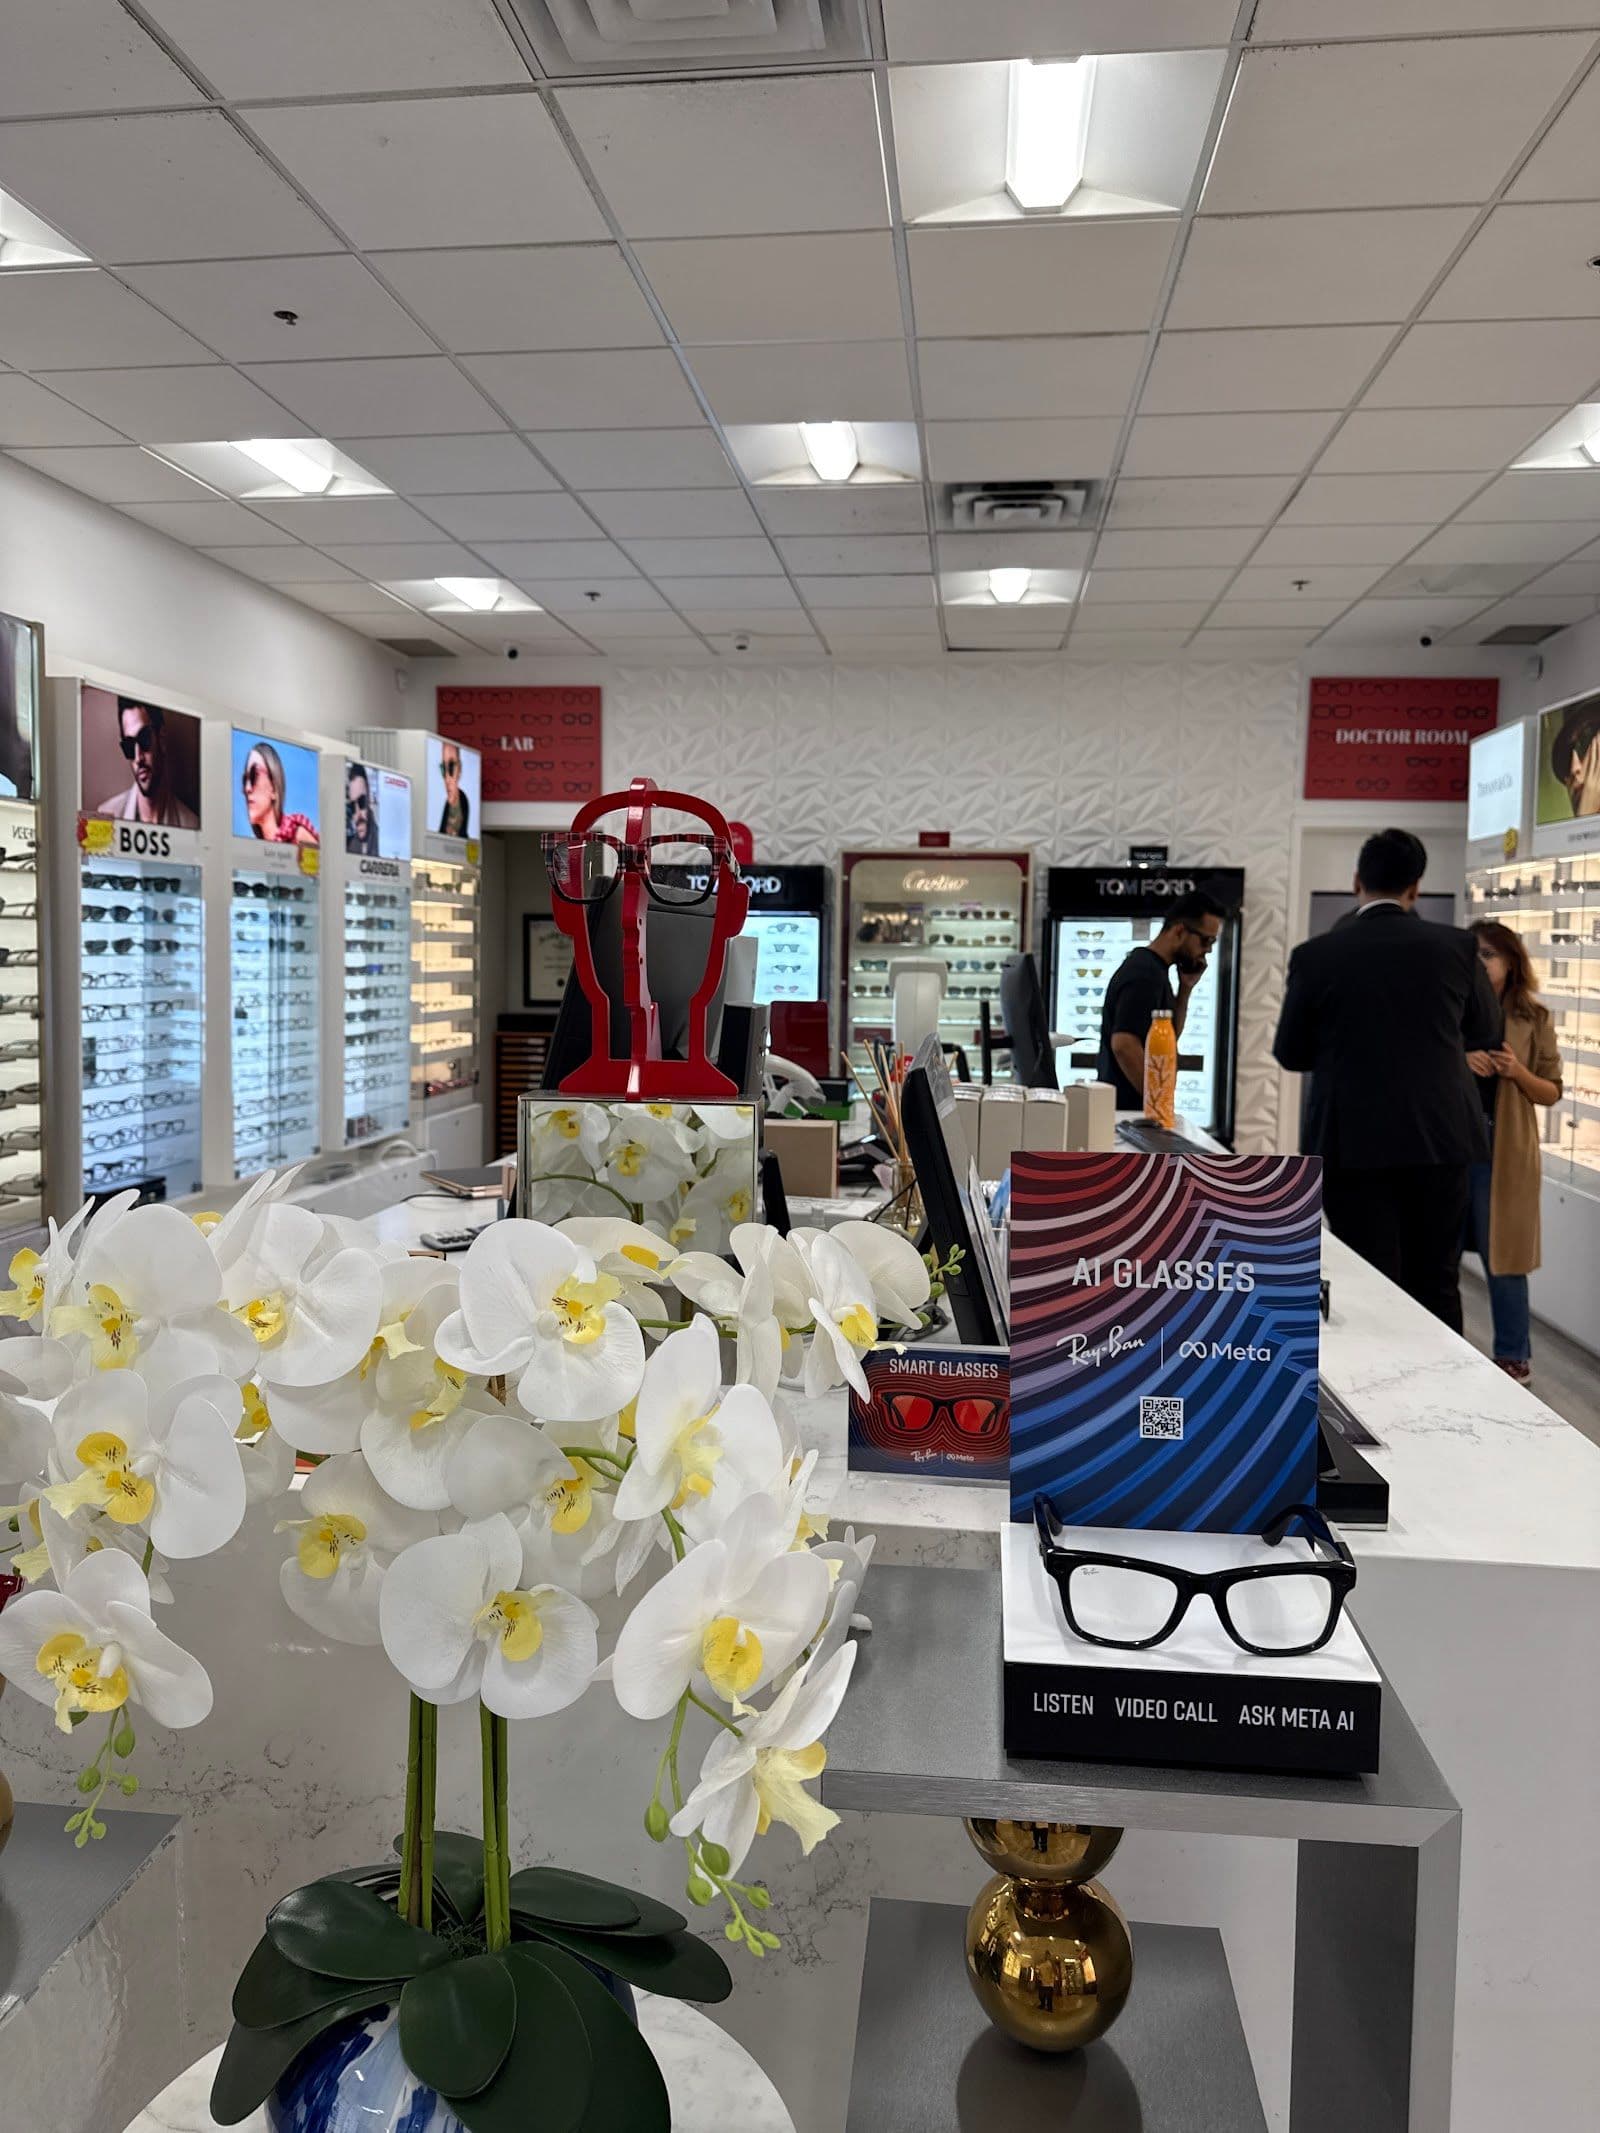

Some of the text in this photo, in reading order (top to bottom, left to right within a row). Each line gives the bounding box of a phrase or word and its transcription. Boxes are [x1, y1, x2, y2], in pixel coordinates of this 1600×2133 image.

[501, 735, 535, 752] LAB
[1335, 728, 1469, 746] DOCTOR ROOM
[119, 826, 171, 857] BOSS
[743, 875, 782, 894] ORD
[1096, 878, 1197, 896] TOM FORD
[1072, 1257, 1255, 1292] AI GLASSES
[1211, 1342, 1271, 1362] Meta
[889, 1358, 998, 1379] SMART GLASSES
[1033, 1692, 1355, 1731] LISTEN VIDEO CALL ASK META AI
